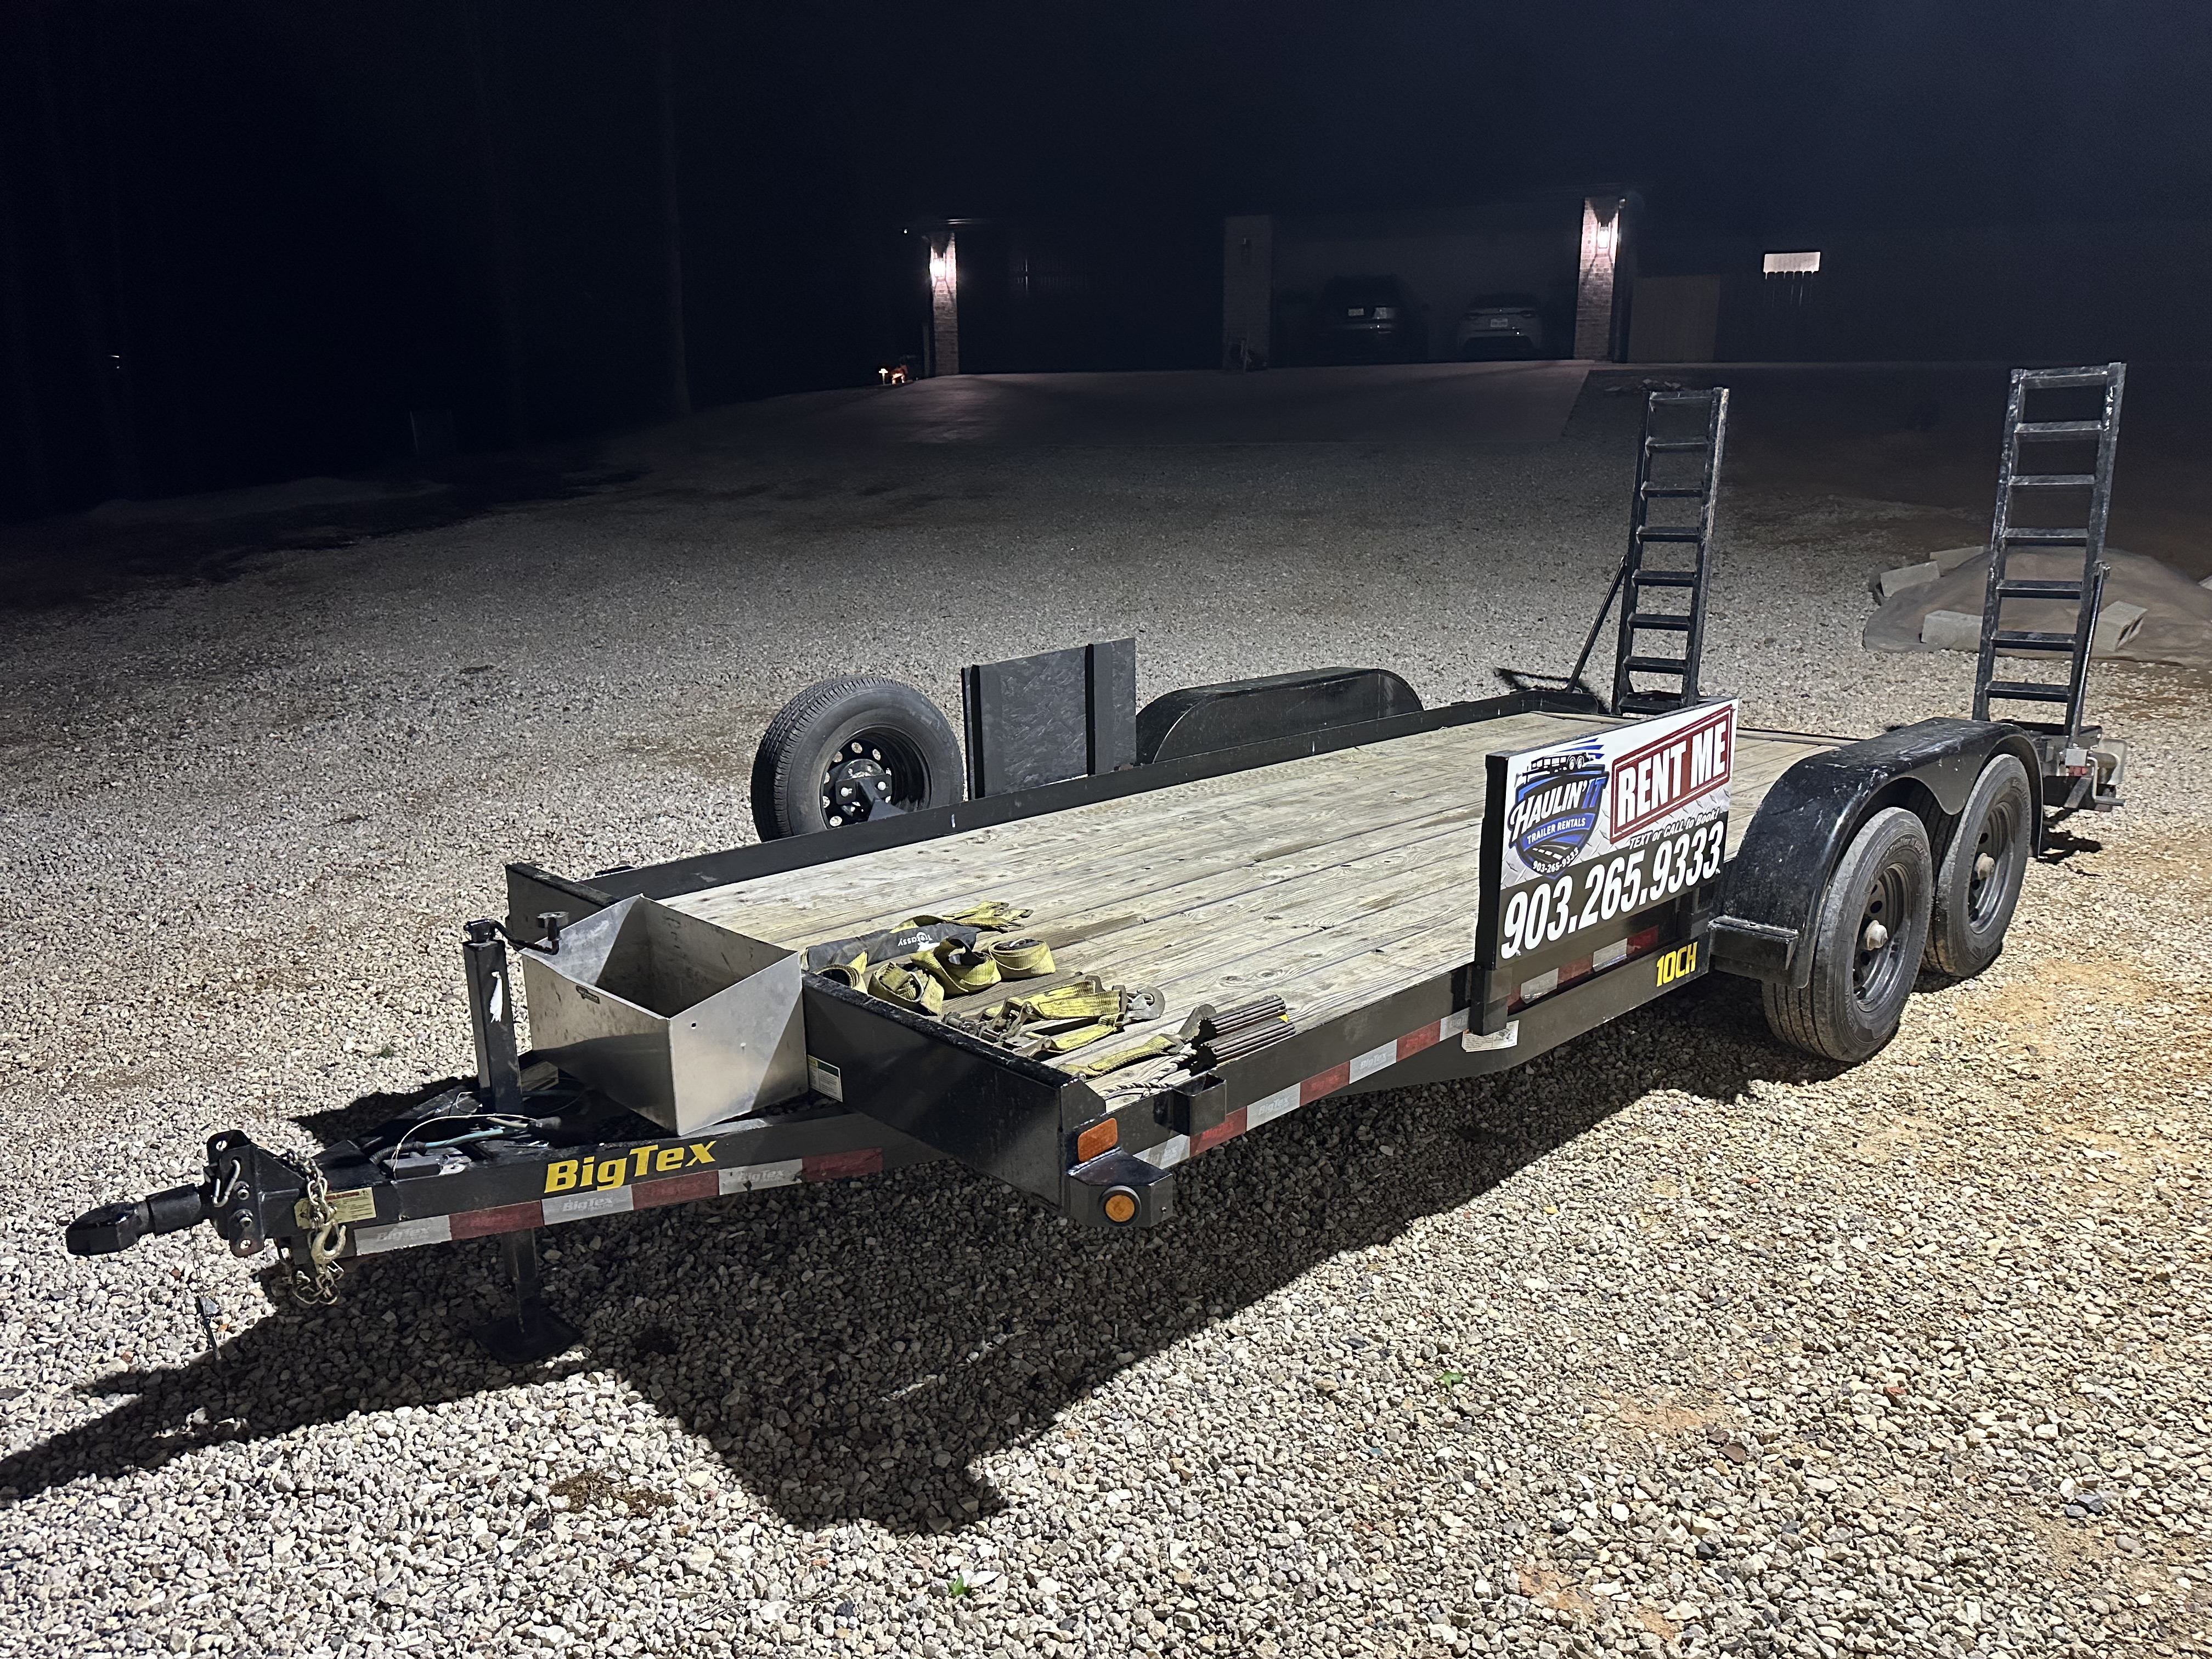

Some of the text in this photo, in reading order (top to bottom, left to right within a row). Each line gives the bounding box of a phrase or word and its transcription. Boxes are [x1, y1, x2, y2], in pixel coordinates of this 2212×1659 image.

[1617, 721, 1728, 827] RENT ME
[1527, 817, 1586, 844] TRAILER RENTALS
[1629, 808, 1720, 850] TEXT or CALL to Book!
[1533, 848, 1579, 872] 903-265-9333
[1500, 821, 1724, 958] 903.265.9333
[1656, 941, 1698, 988] 10CH
[544, 1141, 717, 1194] BigTex
